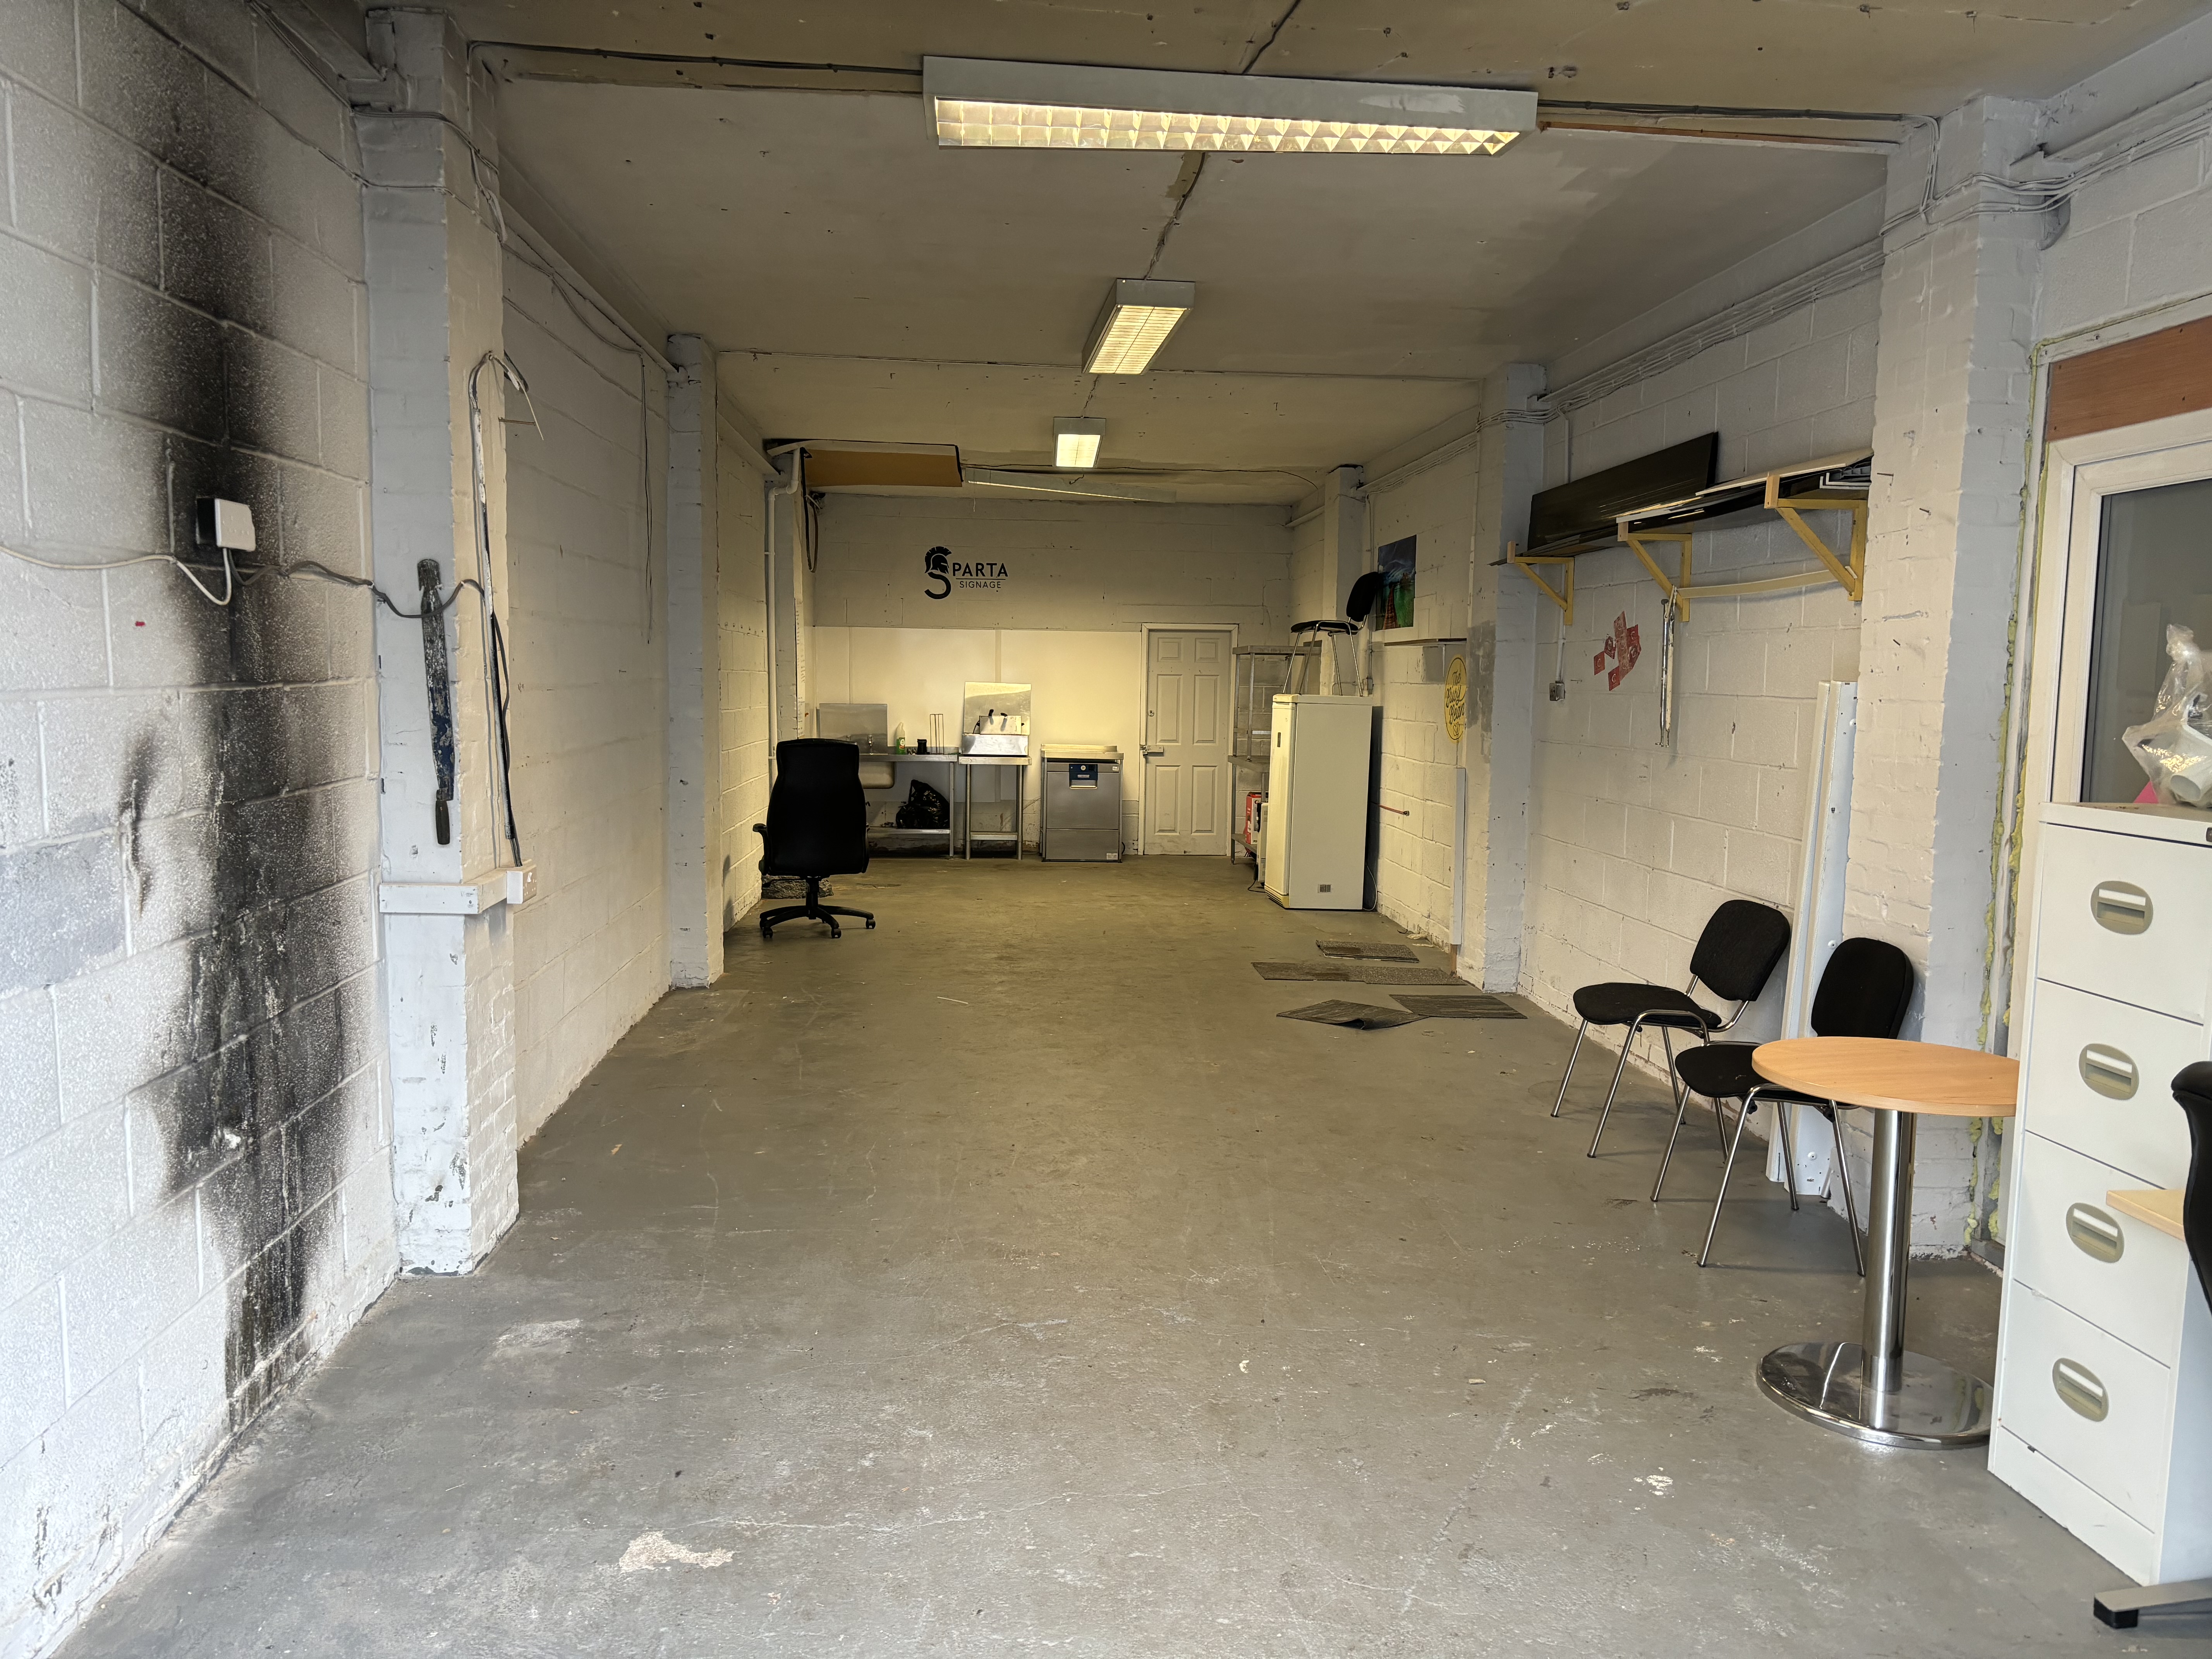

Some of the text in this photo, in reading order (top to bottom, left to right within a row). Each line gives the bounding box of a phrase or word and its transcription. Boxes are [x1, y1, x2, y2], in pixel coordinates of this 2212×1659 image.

[1452, 669, 1461, 687] The
[1446, 685, 1467, 708] Busy
[1449, 702, 1465, 725] Bean
